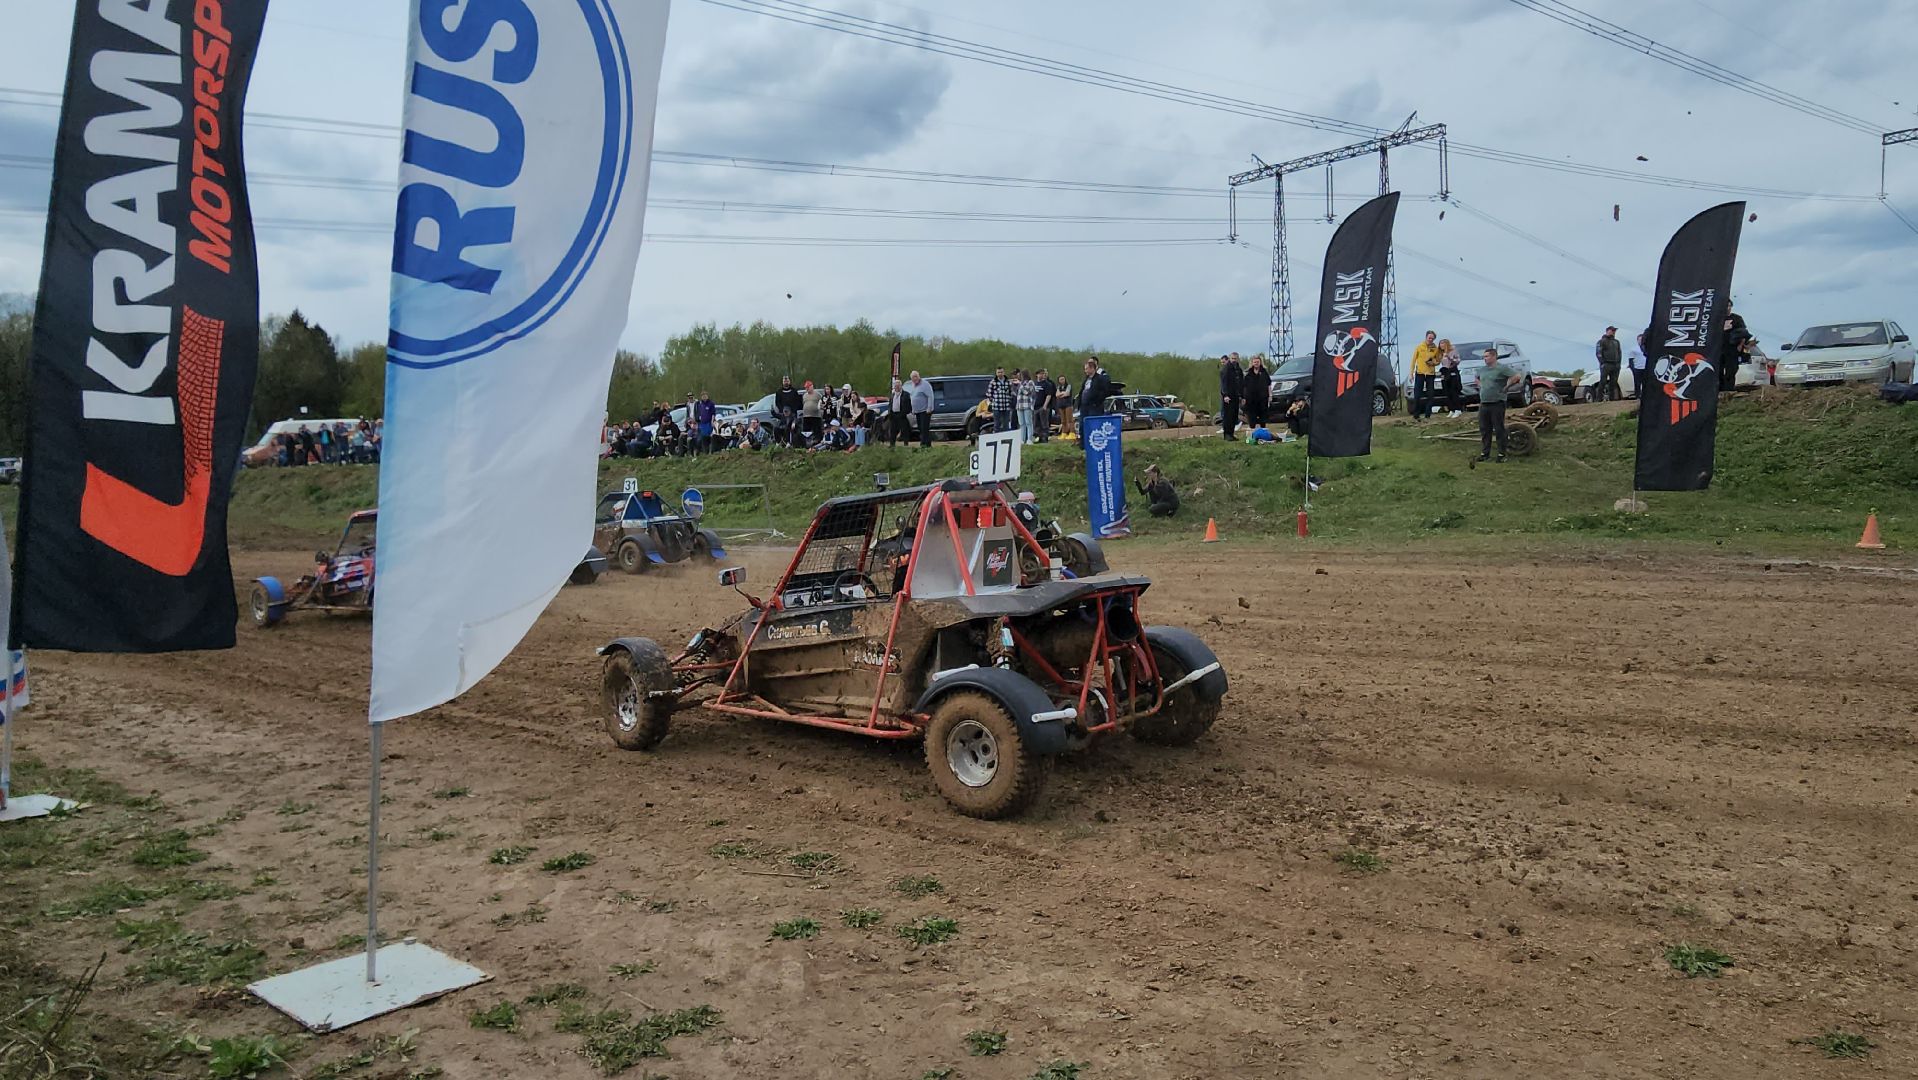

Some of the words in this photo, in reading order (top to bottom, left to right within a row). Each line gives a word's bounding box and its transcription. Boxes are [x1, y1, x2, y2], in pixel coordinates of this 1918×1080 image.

[392, 0, 539, 295] RUS
[1364, 266, 1374, 290] TEAM
[1331, 269, 1365, 324] MSK
[1361, 290, 1371, 321] RACING
[1703, 288, 1715, 313] TEAM
[1664, 289, 1704, 347] MSK
[1697, 314, 1710, 347] RACING
[986, 439, 1013, 475] 77
[625, 480, 636, 491] 31
